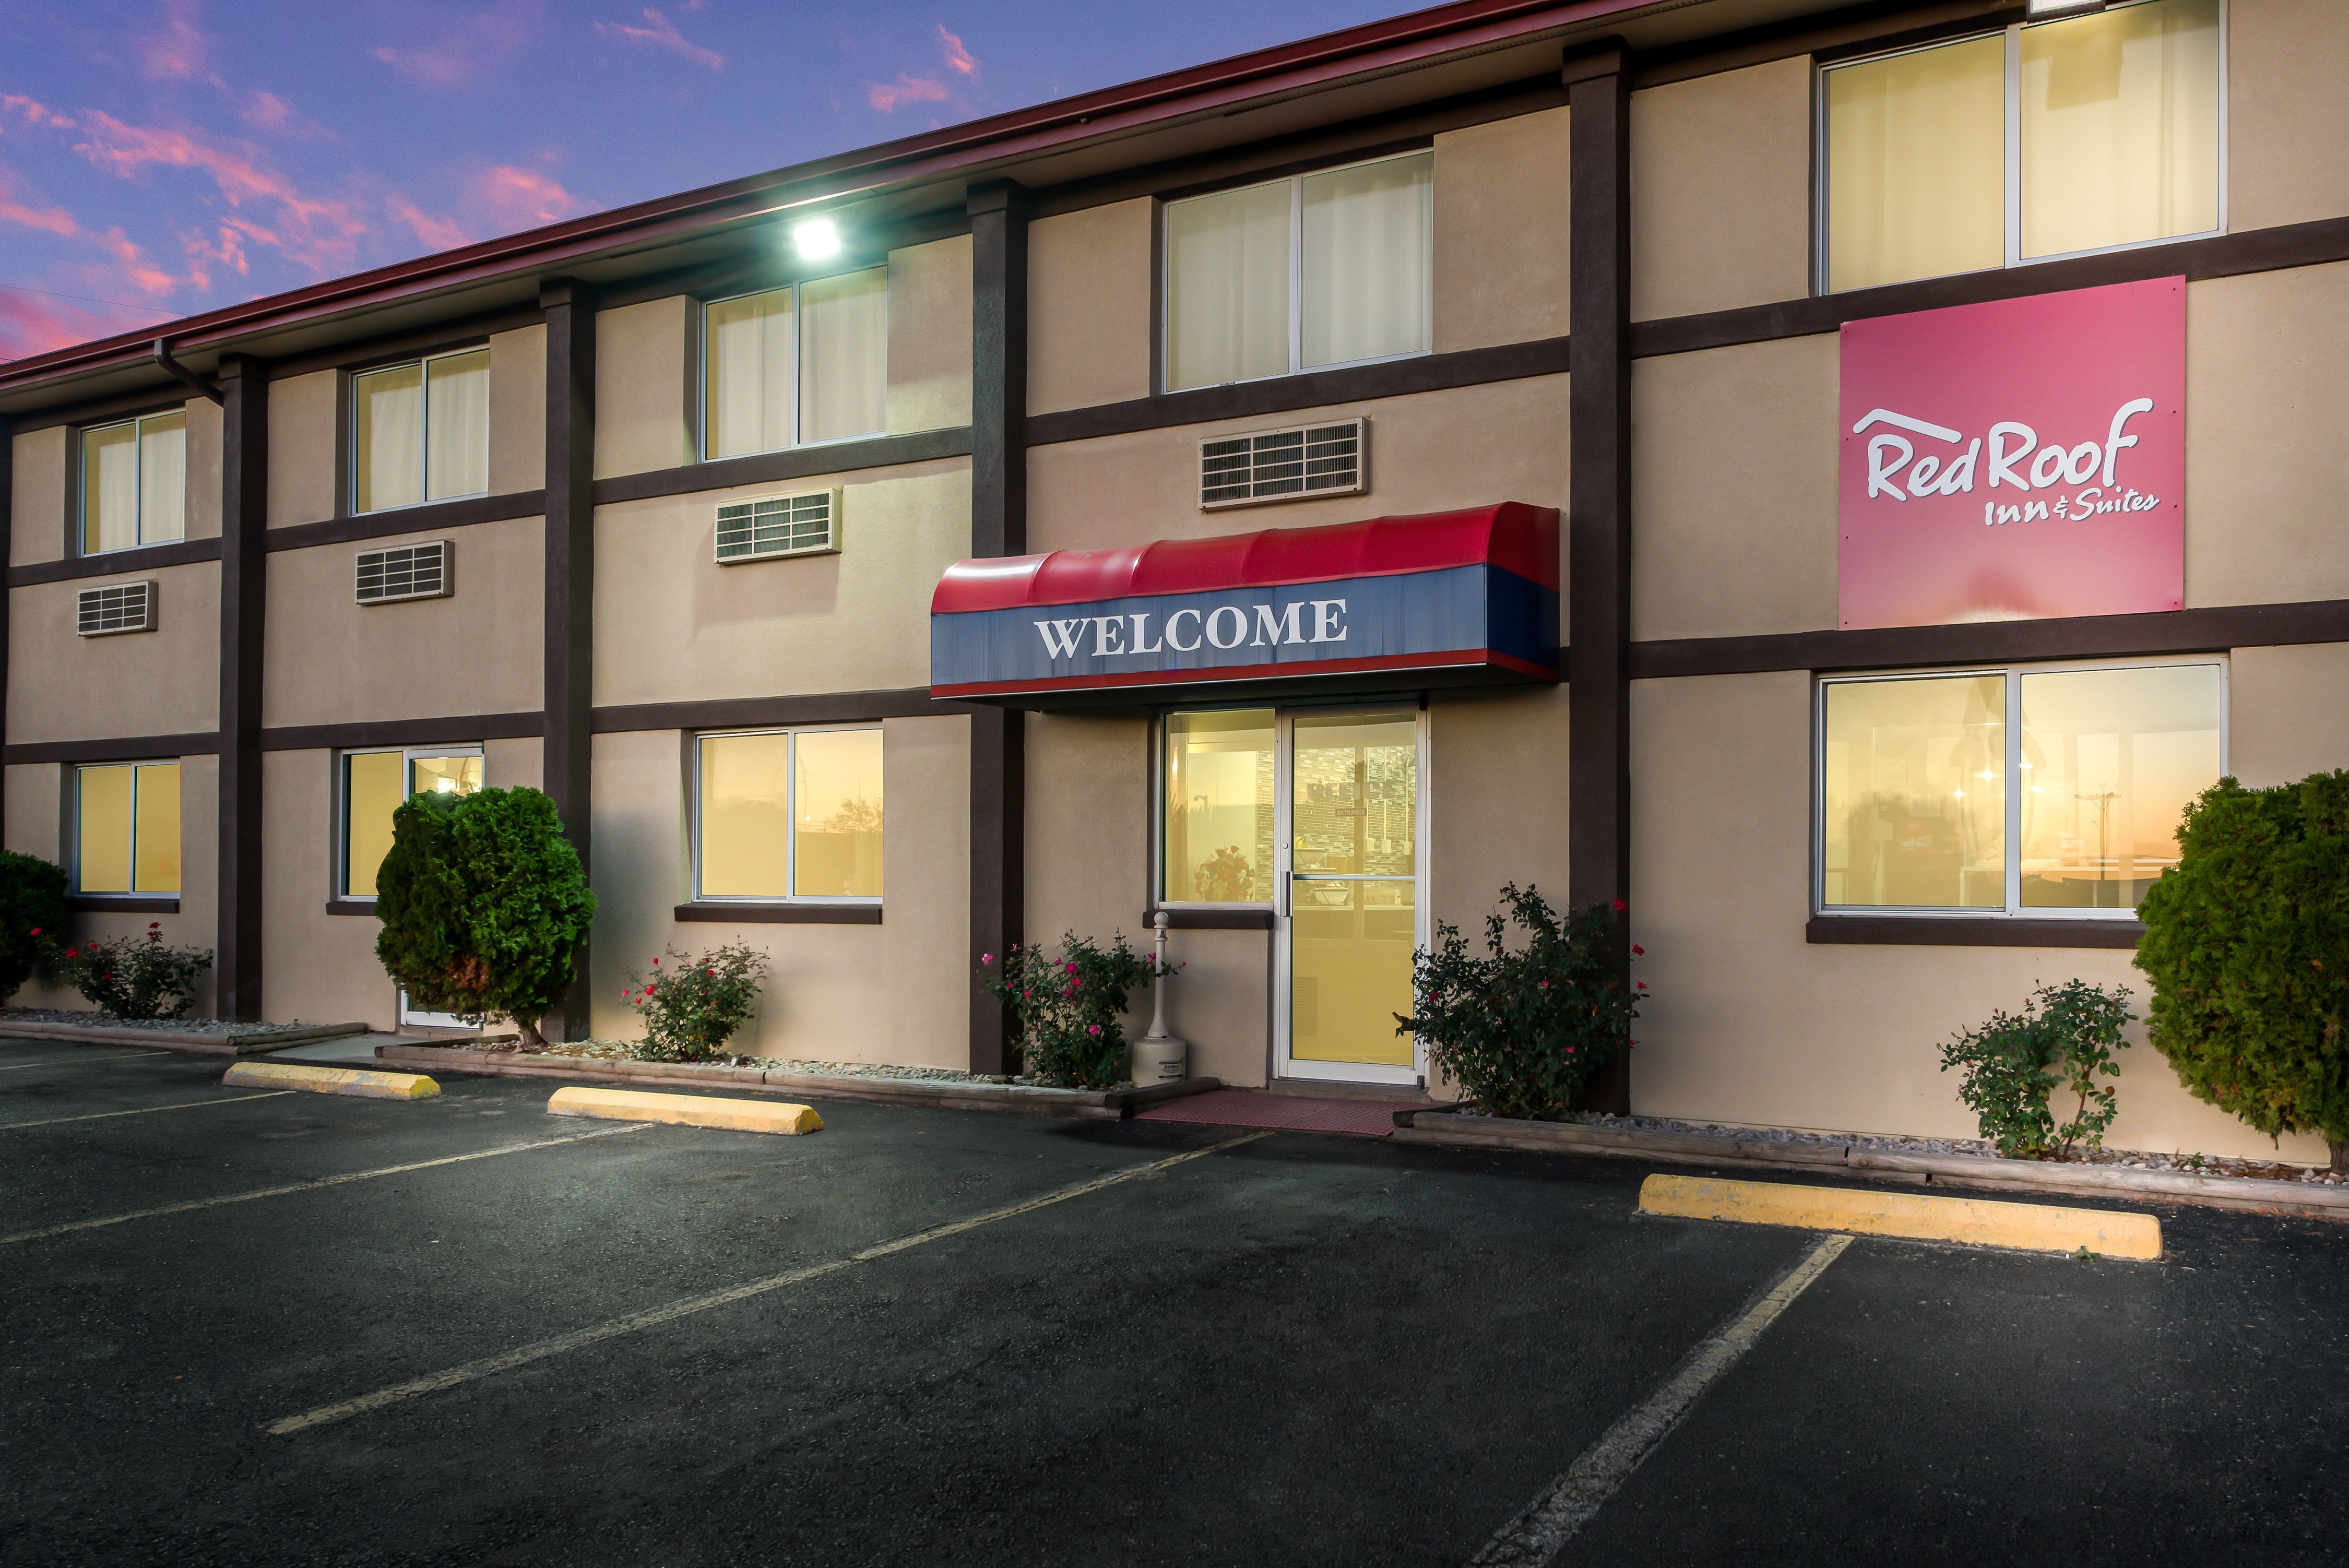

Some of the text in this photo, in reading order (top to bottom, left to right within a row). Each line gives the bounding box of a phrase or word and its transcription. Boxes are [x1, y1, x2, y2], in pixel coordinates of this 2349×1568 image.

[1868, 398, 2154, 502] Red Roof
[1985, 487, 2160, 526] Inn & Suites
[1034, 599, 1347, 660] WELCOME
